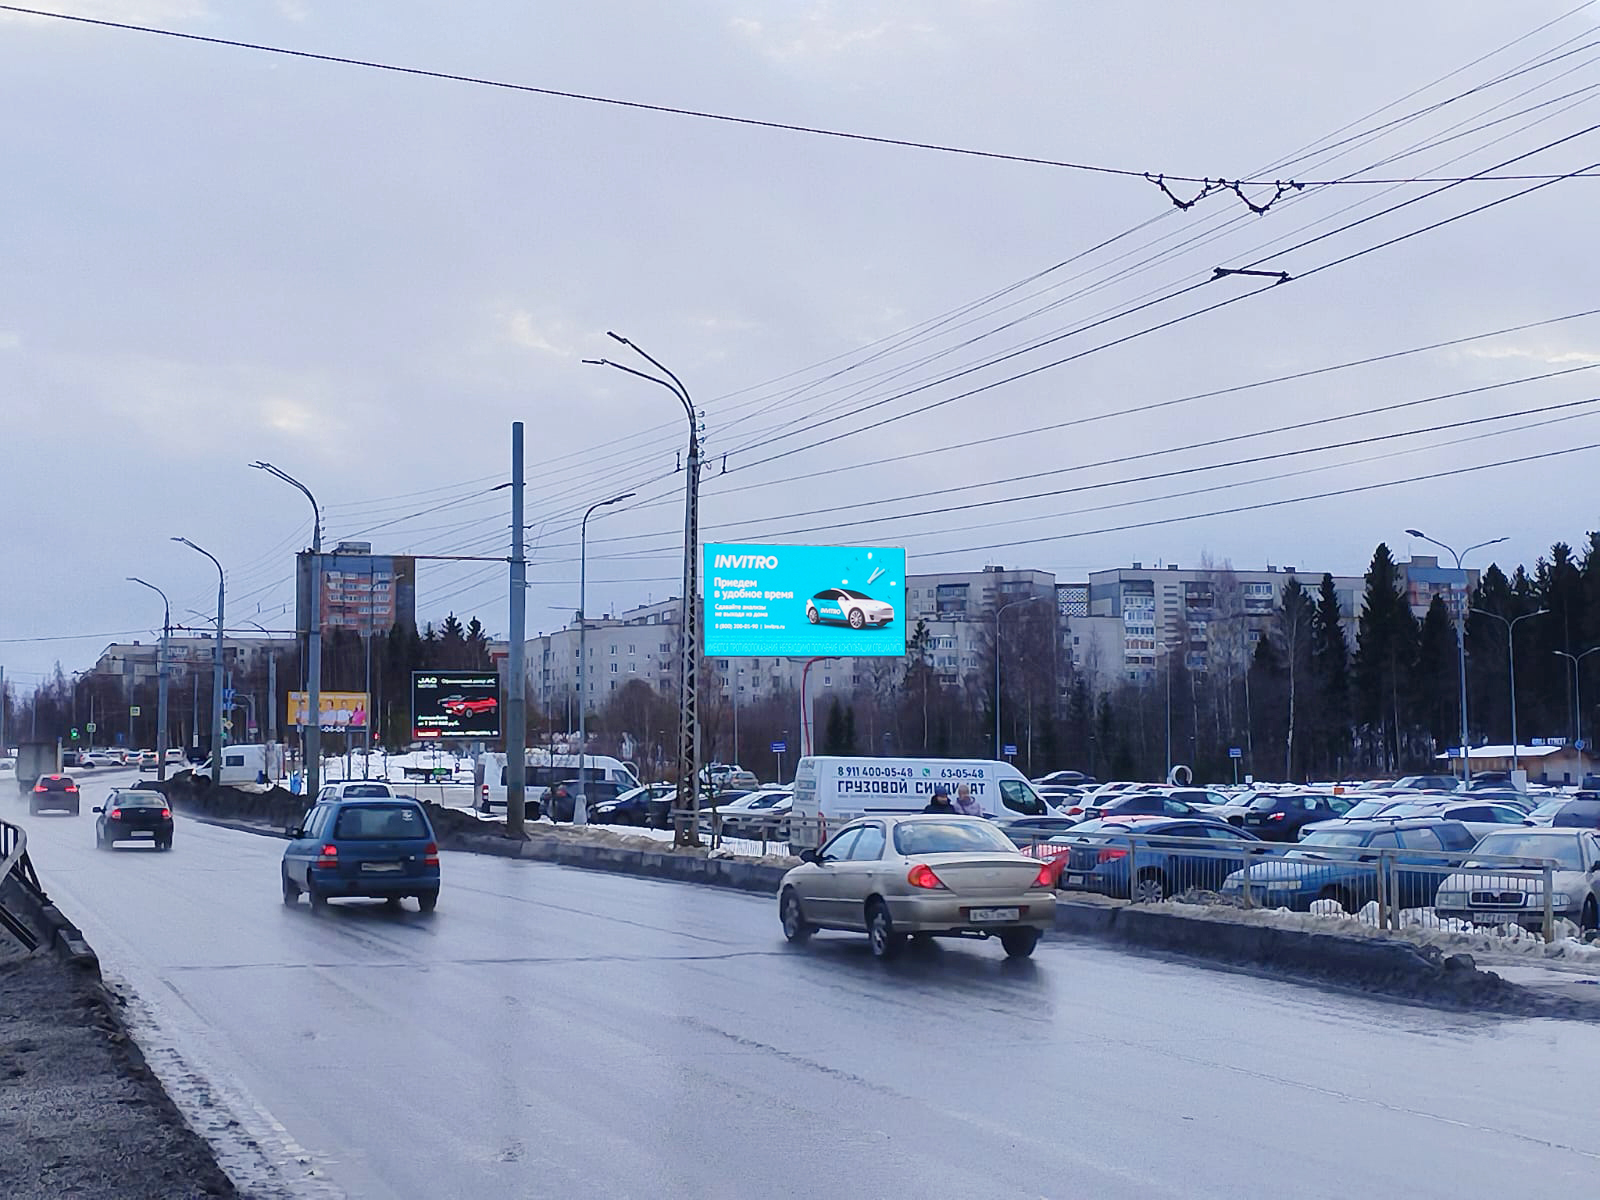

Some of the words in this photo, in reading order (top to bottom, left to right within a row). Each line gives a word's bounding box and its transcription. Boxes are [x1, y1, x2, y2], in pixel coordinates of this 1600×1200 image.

[714, 554, 778, 569] INVITRO
[714, 577, 757, 589] Приедем
[714, 590, 720, 598] в
[722, 589, 762, 600] удобное
[764, 591, 794, 601] время
[838, 766, 844, 776] 8
[846, 766, 860, 776] 911
[862, 766, 913, 777] 400-05-48
[941, 768, 984, 778] 63-05-48
[838, 778, 908, 794] ГРУЗОВОЙ
[915, 781, 985, 795] СИДИАТ
